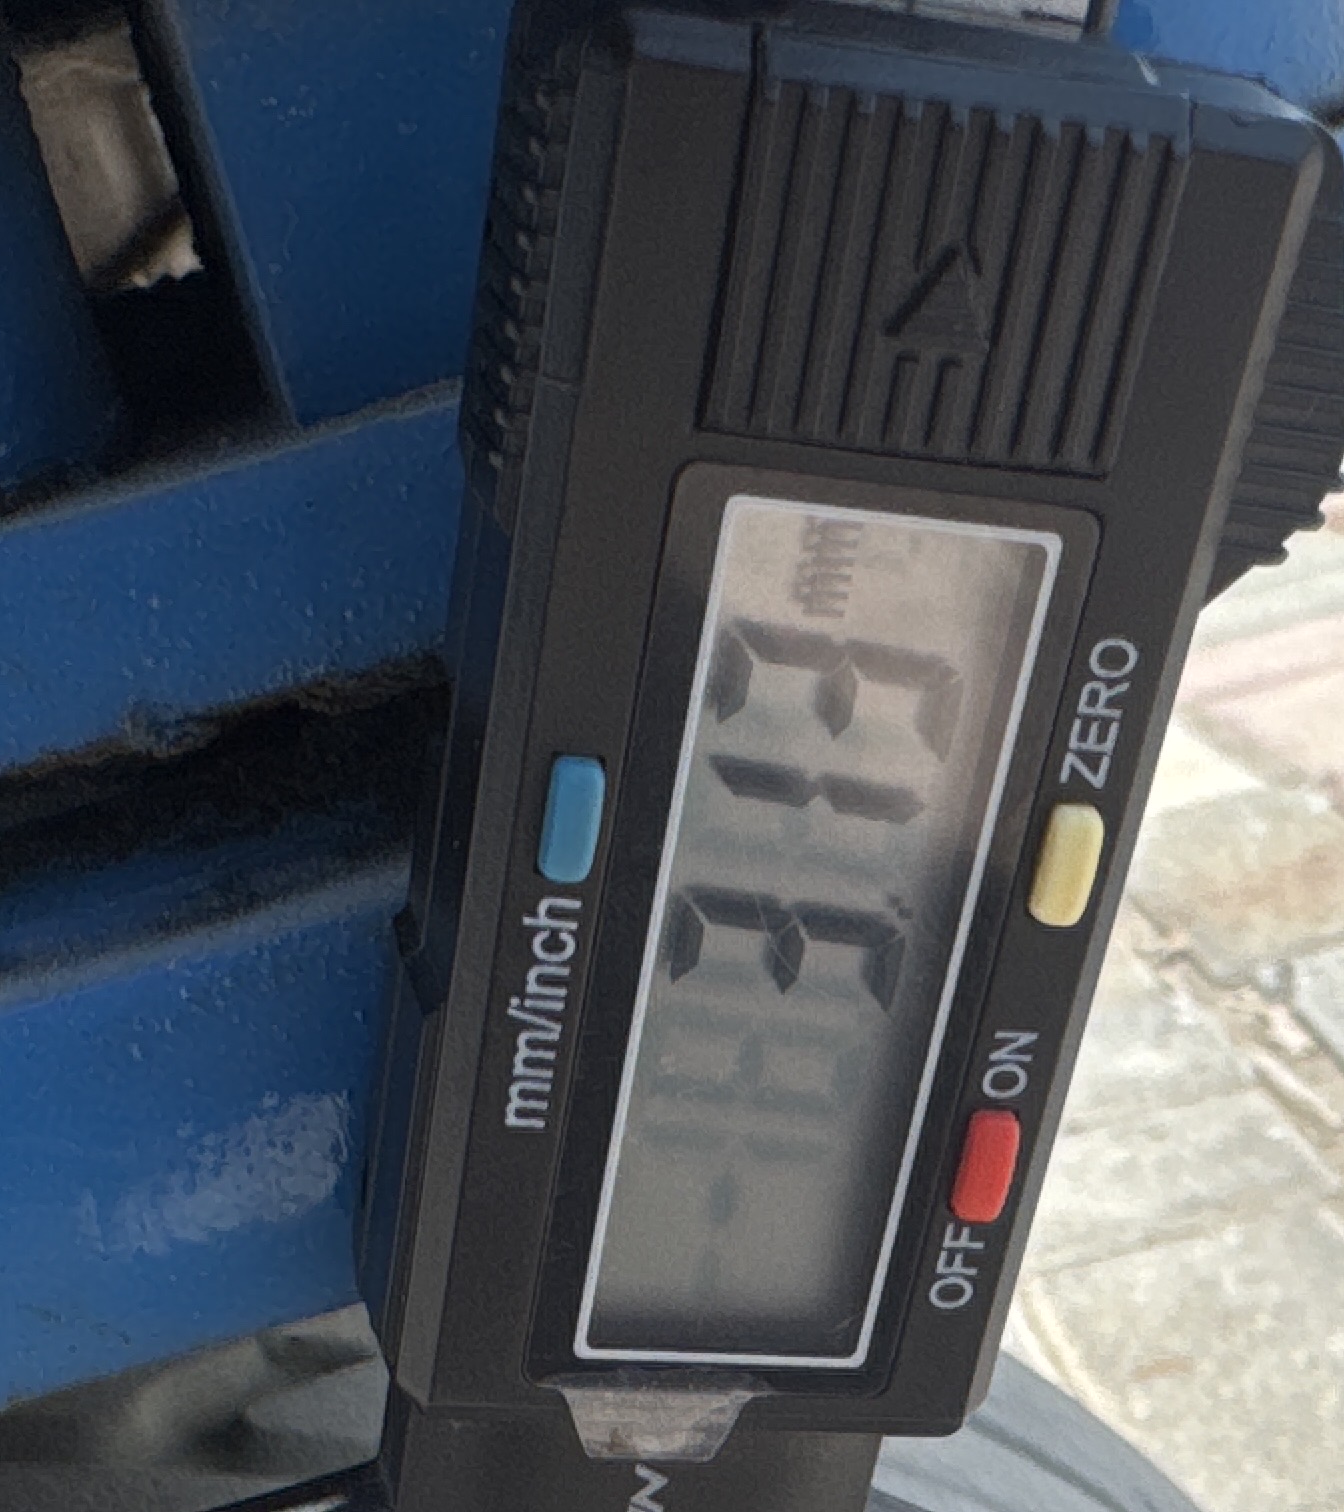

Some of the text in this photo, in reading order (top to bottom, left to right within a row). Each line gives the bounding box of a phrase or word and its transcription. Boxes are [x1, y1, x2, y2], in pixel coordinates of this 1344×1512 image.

[1061, 637, 1139, 790] ZERO
[502, 897, 584, 1130] mm/inch
[980, 1029, 1040, 1101] ON
[927, 1224, 987, 1310] OFF
